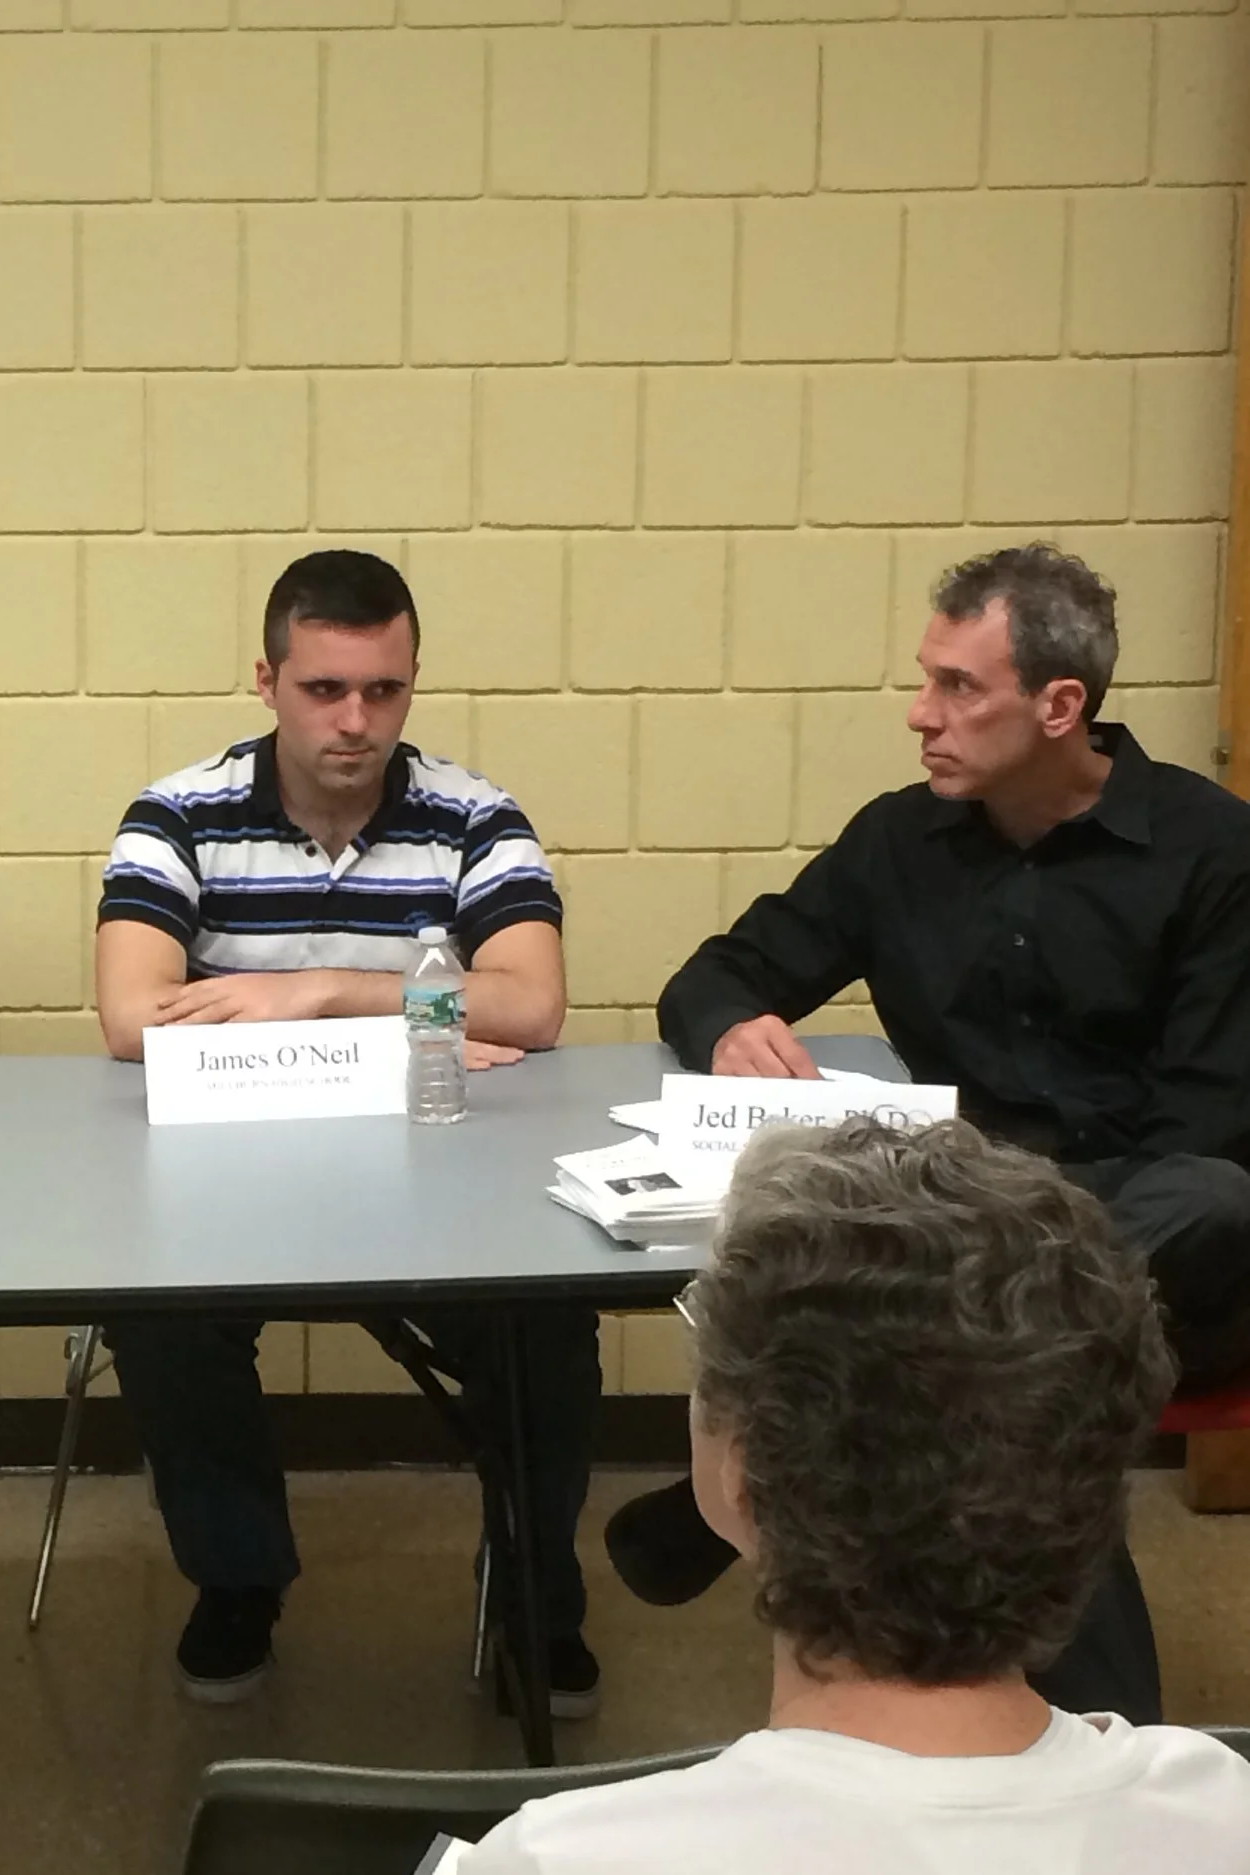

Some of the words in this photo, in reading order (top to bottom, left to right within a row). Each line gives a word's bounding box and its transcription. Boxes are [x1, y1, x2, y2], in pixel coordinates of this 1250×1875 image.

[196, 1050, 269, 1072] James
[693, 1104, 736, 1129] Jed
[746, 1105, 826, 1129] Bker
